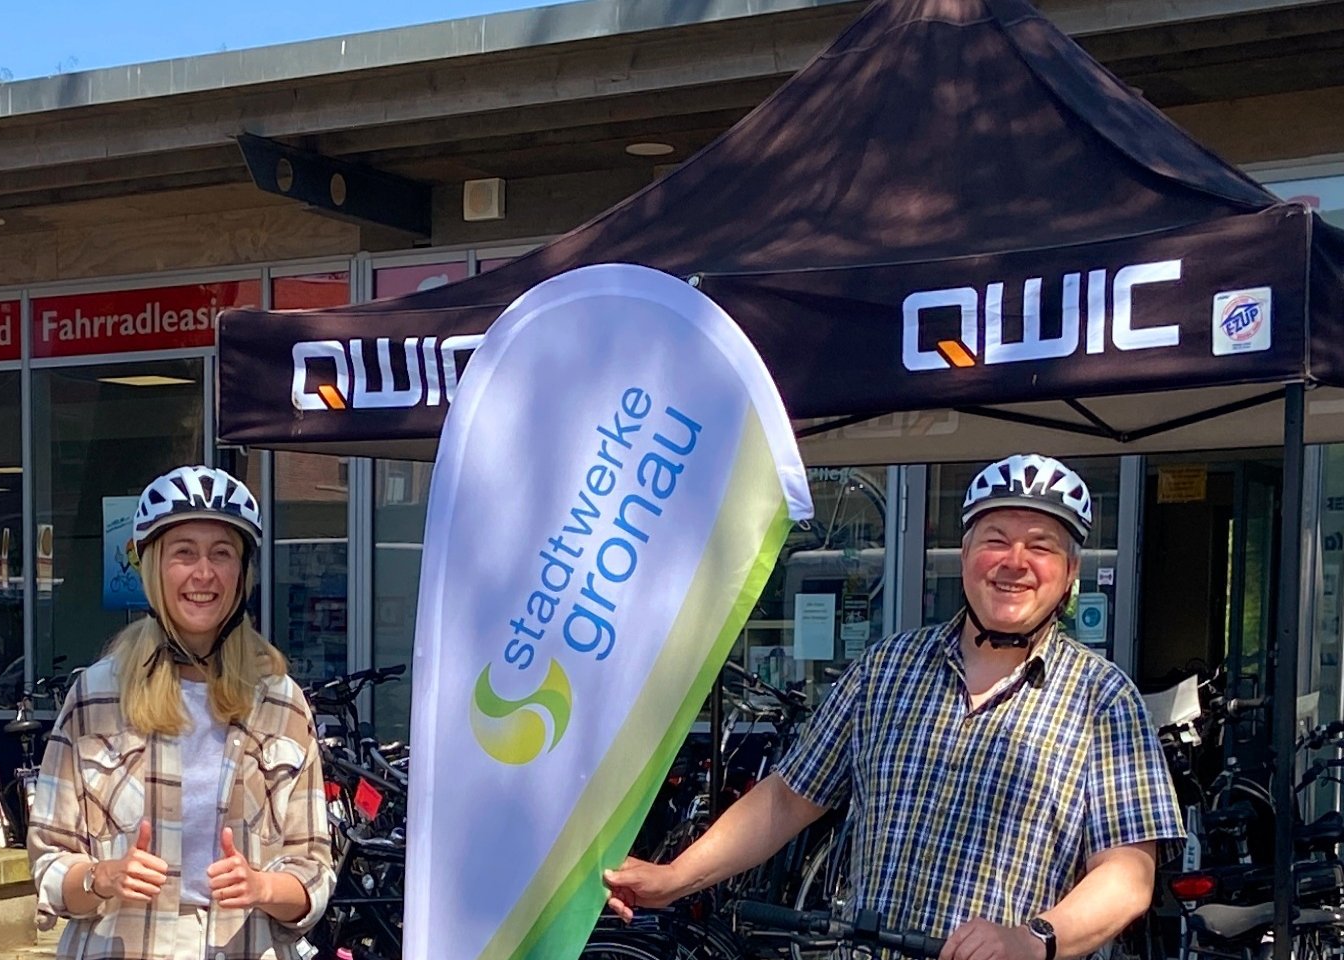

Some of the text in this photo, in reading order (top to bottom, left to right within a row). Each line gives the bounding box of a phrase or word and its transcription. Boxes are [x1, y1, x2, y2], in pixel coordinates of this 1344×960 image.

[42, 299, 221, 343] Fahrradleasi
[902, 258, 1183, 372] QWIC
[503, 386, 654, 671] stadtwerke
[562, 405, 704, 663] gronau
